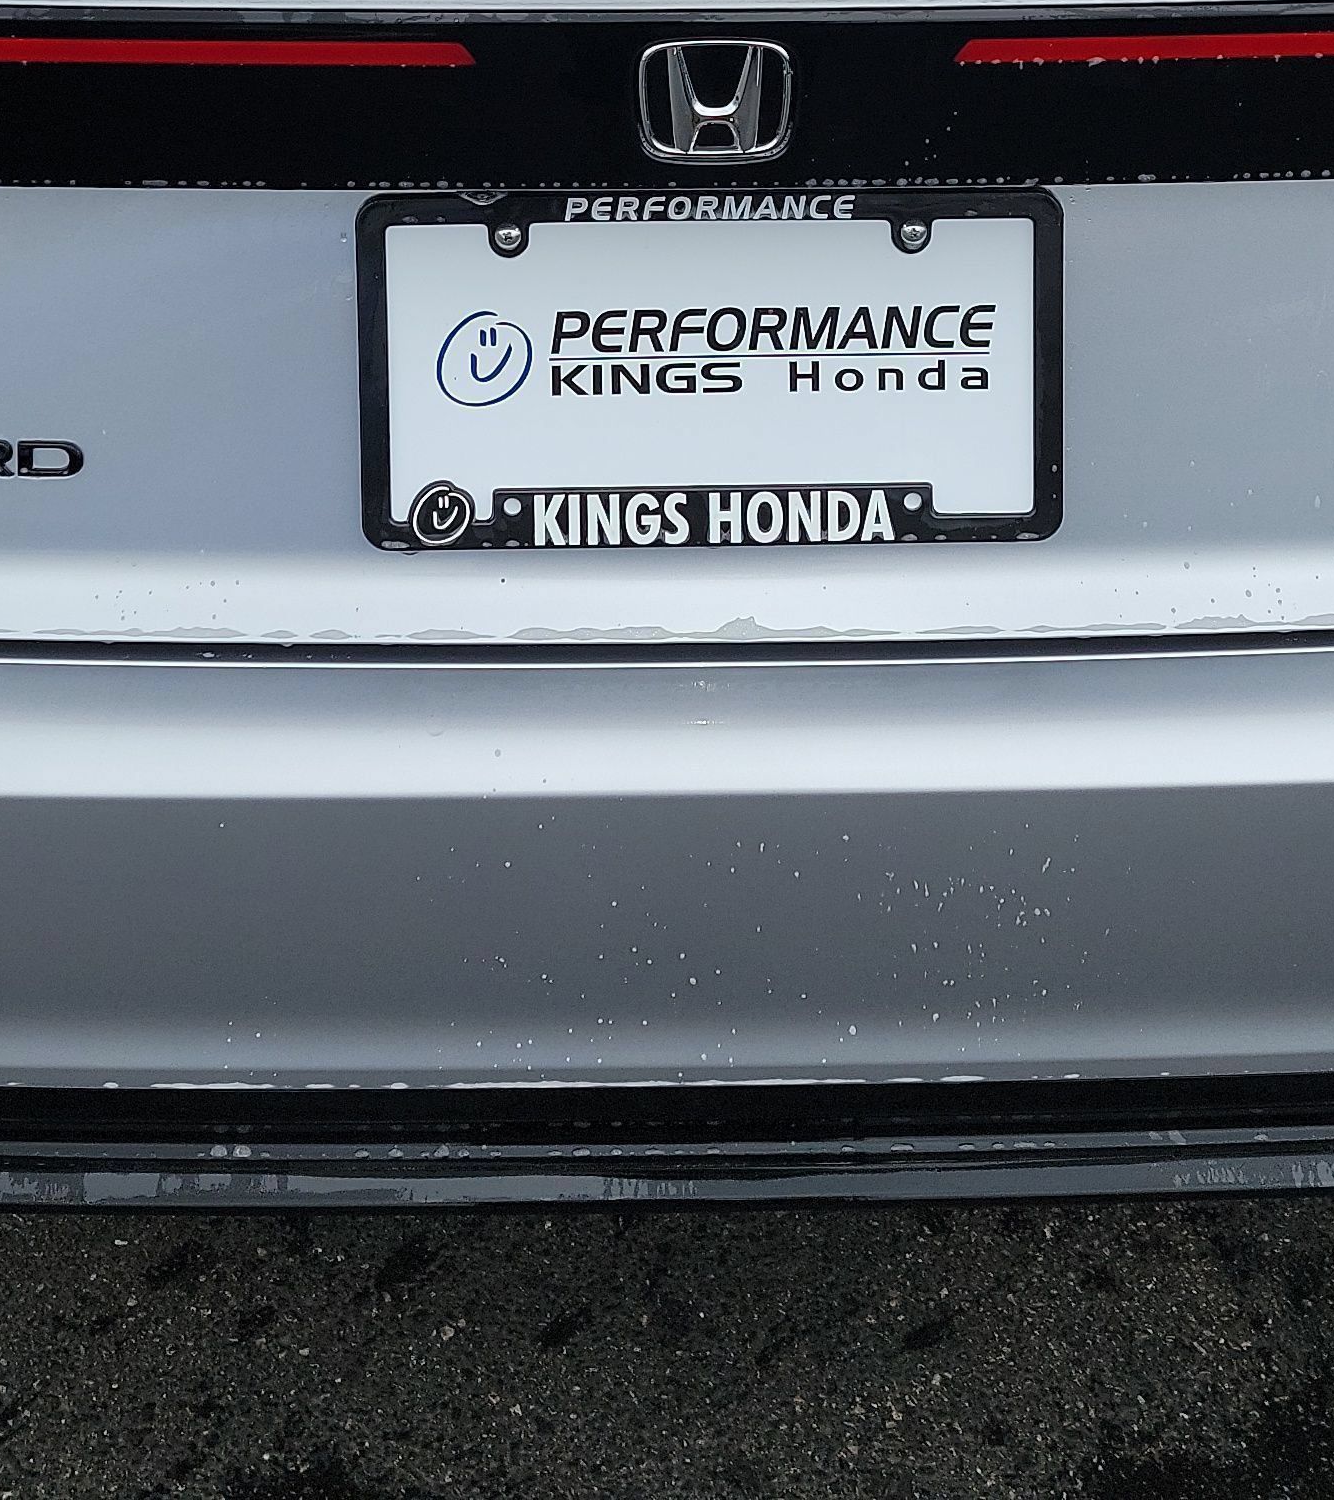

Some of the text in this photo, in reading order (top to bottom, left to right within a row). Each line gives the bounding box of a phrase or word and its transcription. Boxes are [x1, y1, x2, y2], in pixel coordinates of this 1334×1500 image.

[564, 194, 856, 221] PERFORMANCE
[549, 304, 997, 354] PERFORMANCE
[550, 359, 991, 396] KINGS Honda
[532, 490, 896, 547] KINGS HONDA
